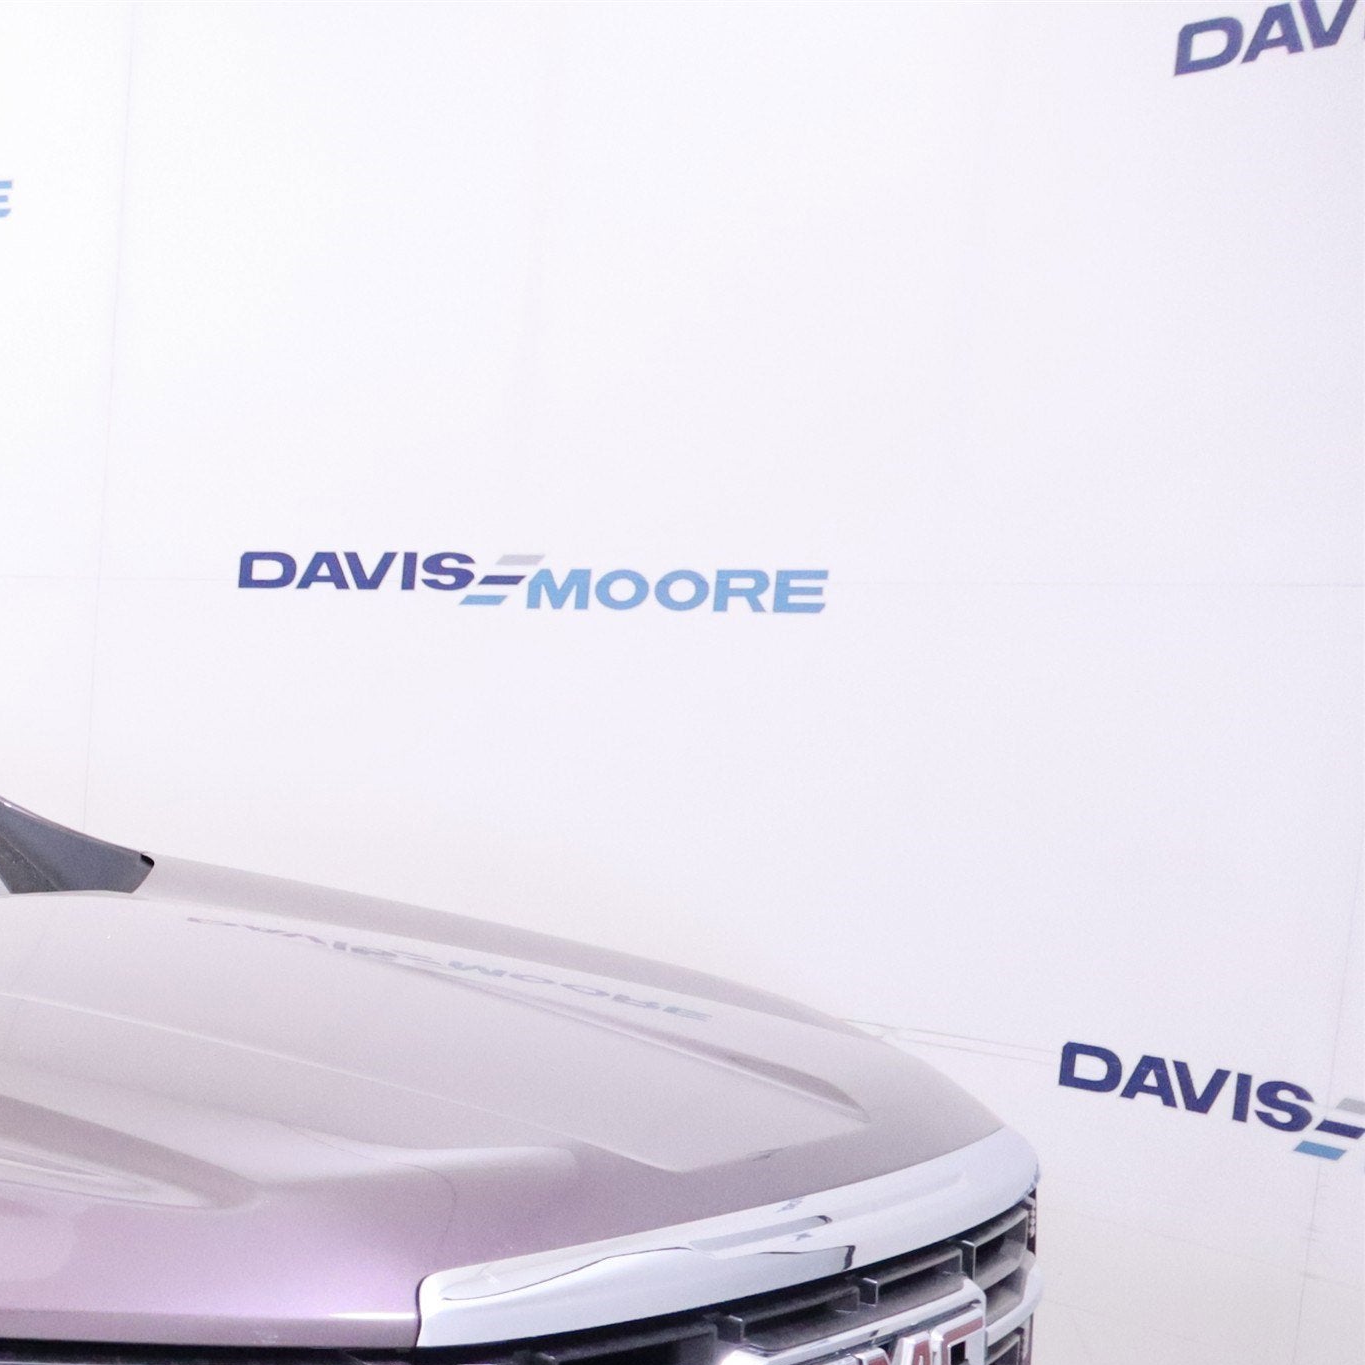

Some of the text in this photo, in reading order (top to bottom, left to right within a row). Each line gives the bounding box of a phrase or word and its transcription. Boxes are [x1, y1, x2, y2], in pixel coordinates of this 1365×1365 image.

[1174, 0, 1365, 76] DAV
[238, 551, 829, 614] DAVIS MOORE
[1058, 1041, 1315, 1132] DAVIS
